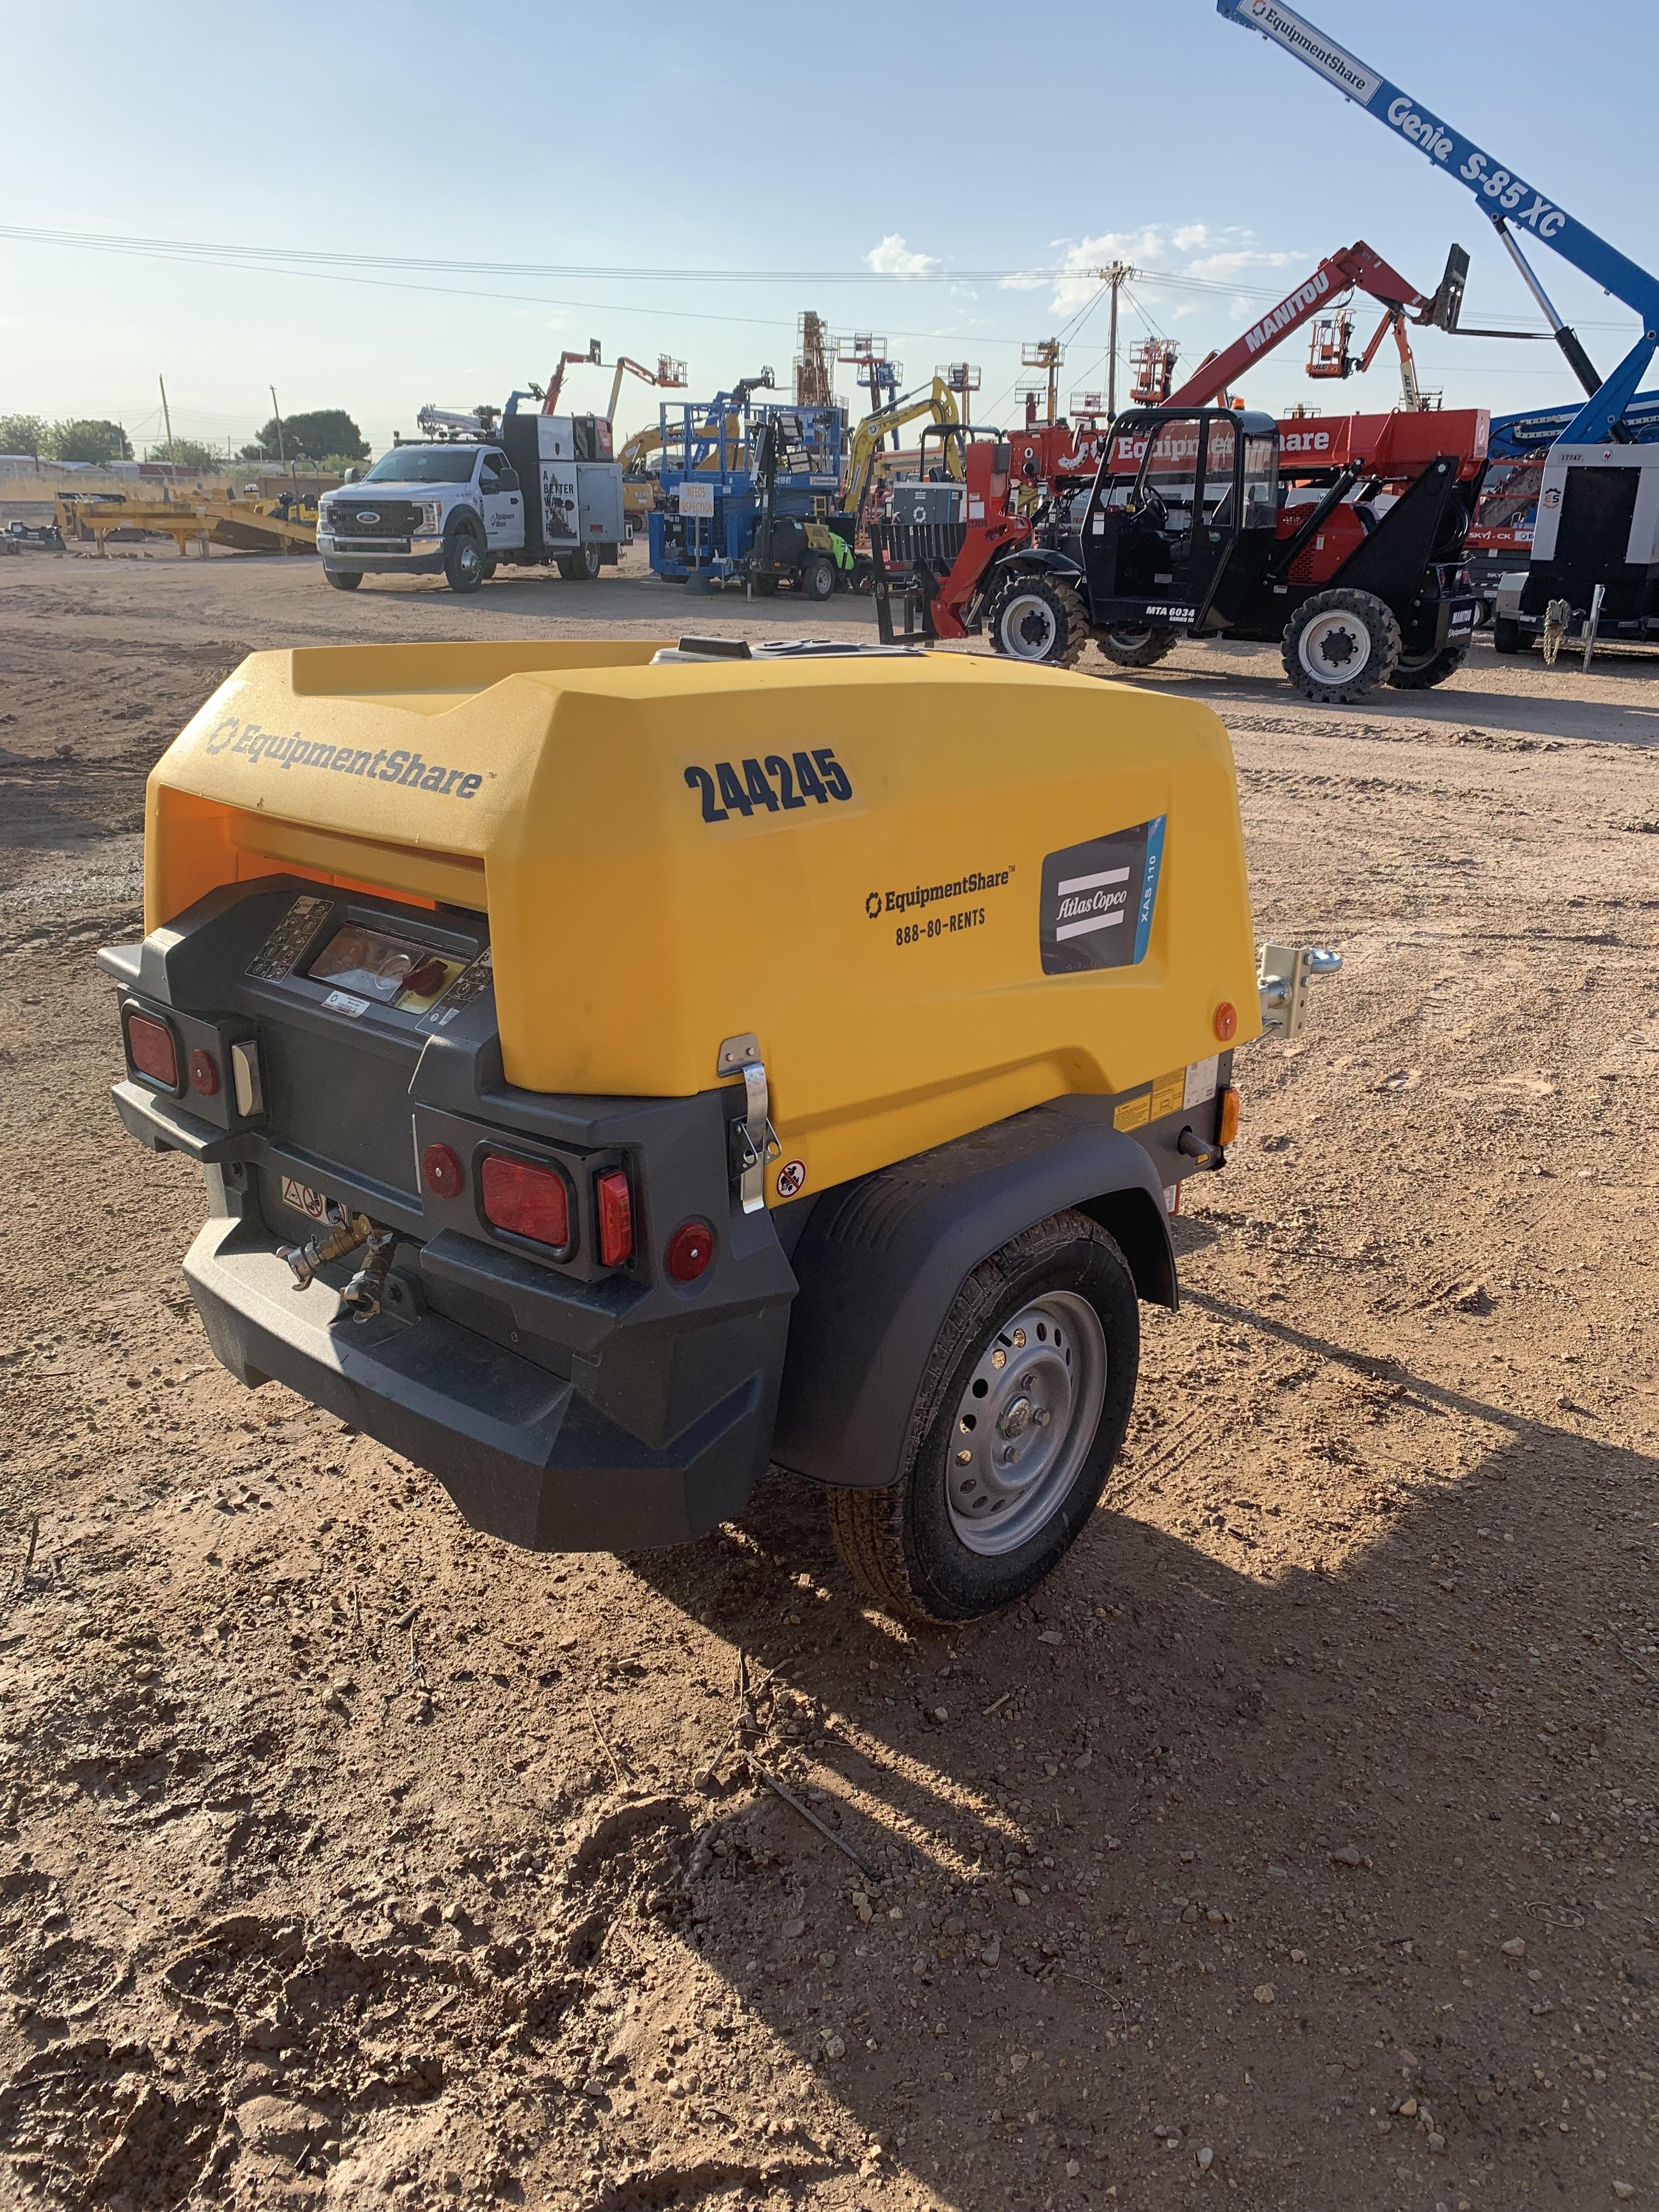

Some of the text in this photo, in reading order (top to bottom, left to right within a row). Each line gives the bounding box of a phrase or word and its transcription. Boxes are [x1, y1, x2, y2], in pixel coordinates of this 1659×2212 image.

[1265, 8, 1365, 90] EquipmentShare
[1387, 97, 1566, 237] Genie S-85 XC
[1245, 270, 1329, 353] MANITOU
[543, 470, 549, 481] A
[544, 483, 574, 494] BETTER
[687, 486, 706, 498] NEEDS
[680, 501, 713, 513] INSPECTION
[1469, 530, 1511, 540] SKYJCK
[1146, 606, 1195, 617] MTA 6034
[231, 724, 483, 799] EquipmentShare
[684, 748, 853, 823] 244245
[885, 870, 1009, 913] EquipmentShare
[1141, 855, 1156, 923] XAS 110
[895, 908, 985, 946] 888-80-RENTS
